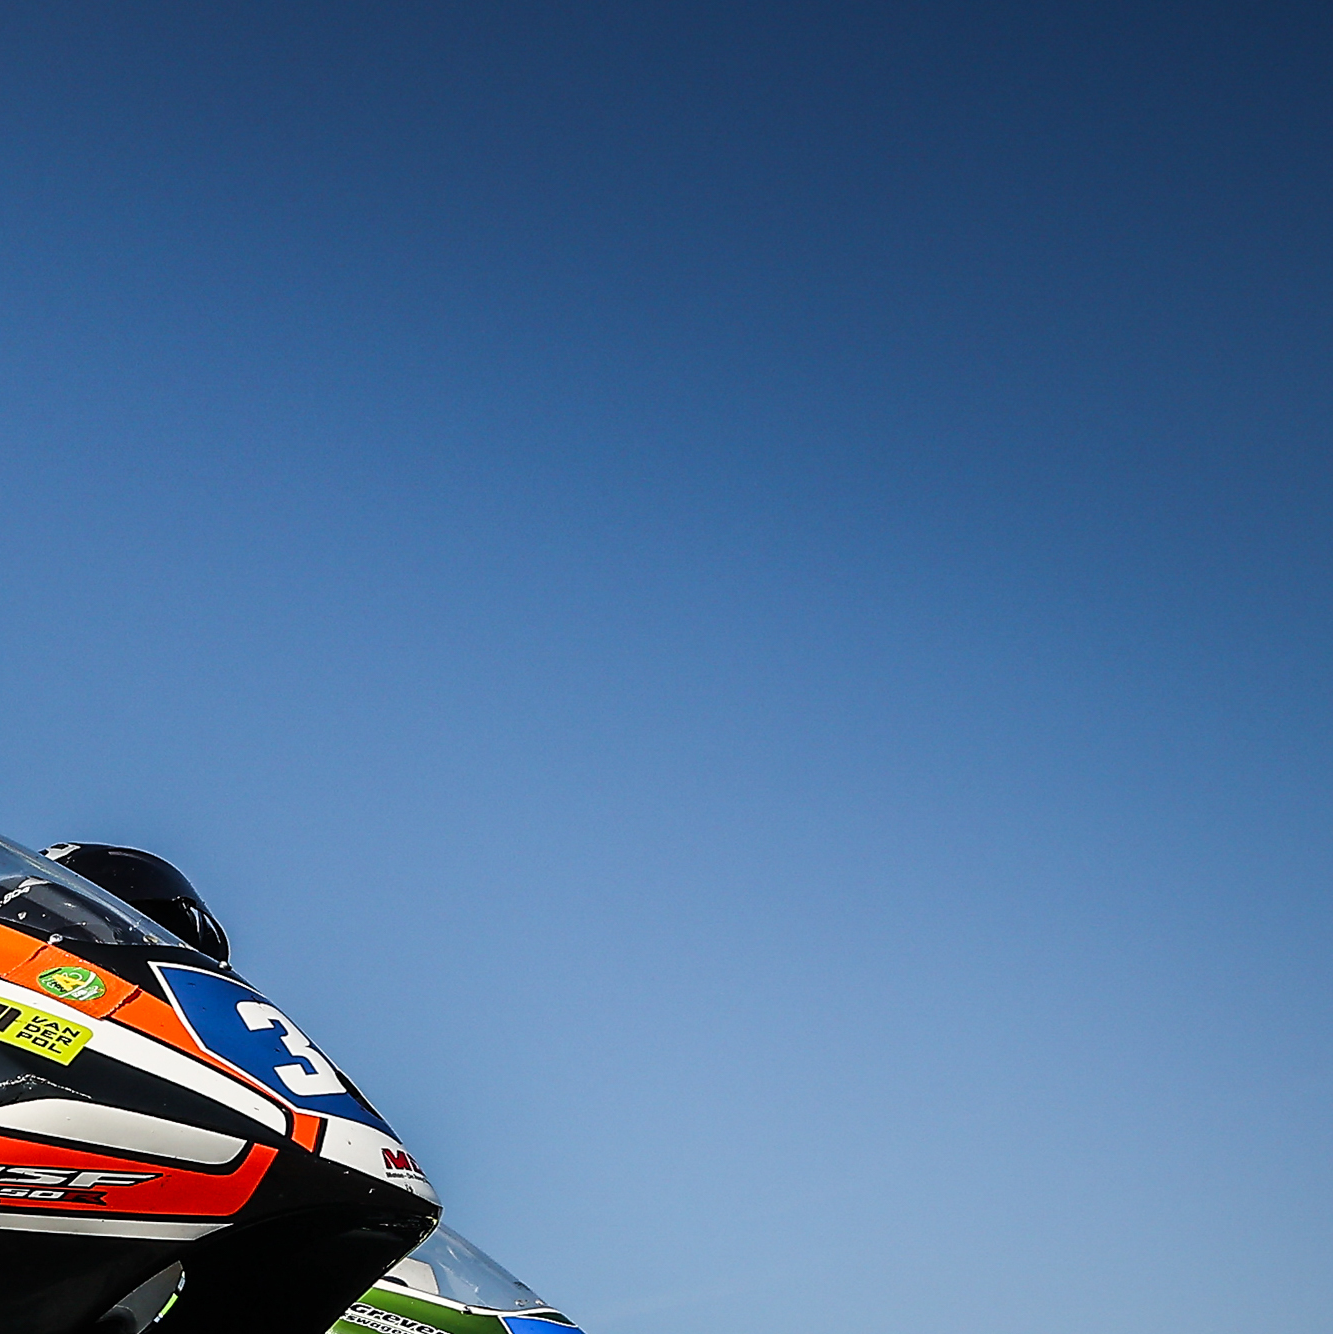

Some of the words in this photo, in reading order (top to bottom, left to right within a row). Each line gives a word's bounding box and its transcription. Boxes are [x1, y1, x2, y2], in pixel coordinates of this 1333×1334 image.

[24, 1023, 73, 1047] DER
[31, 1015, 81, 1038] VAN
[15, 1031, 63, 1054] POL
